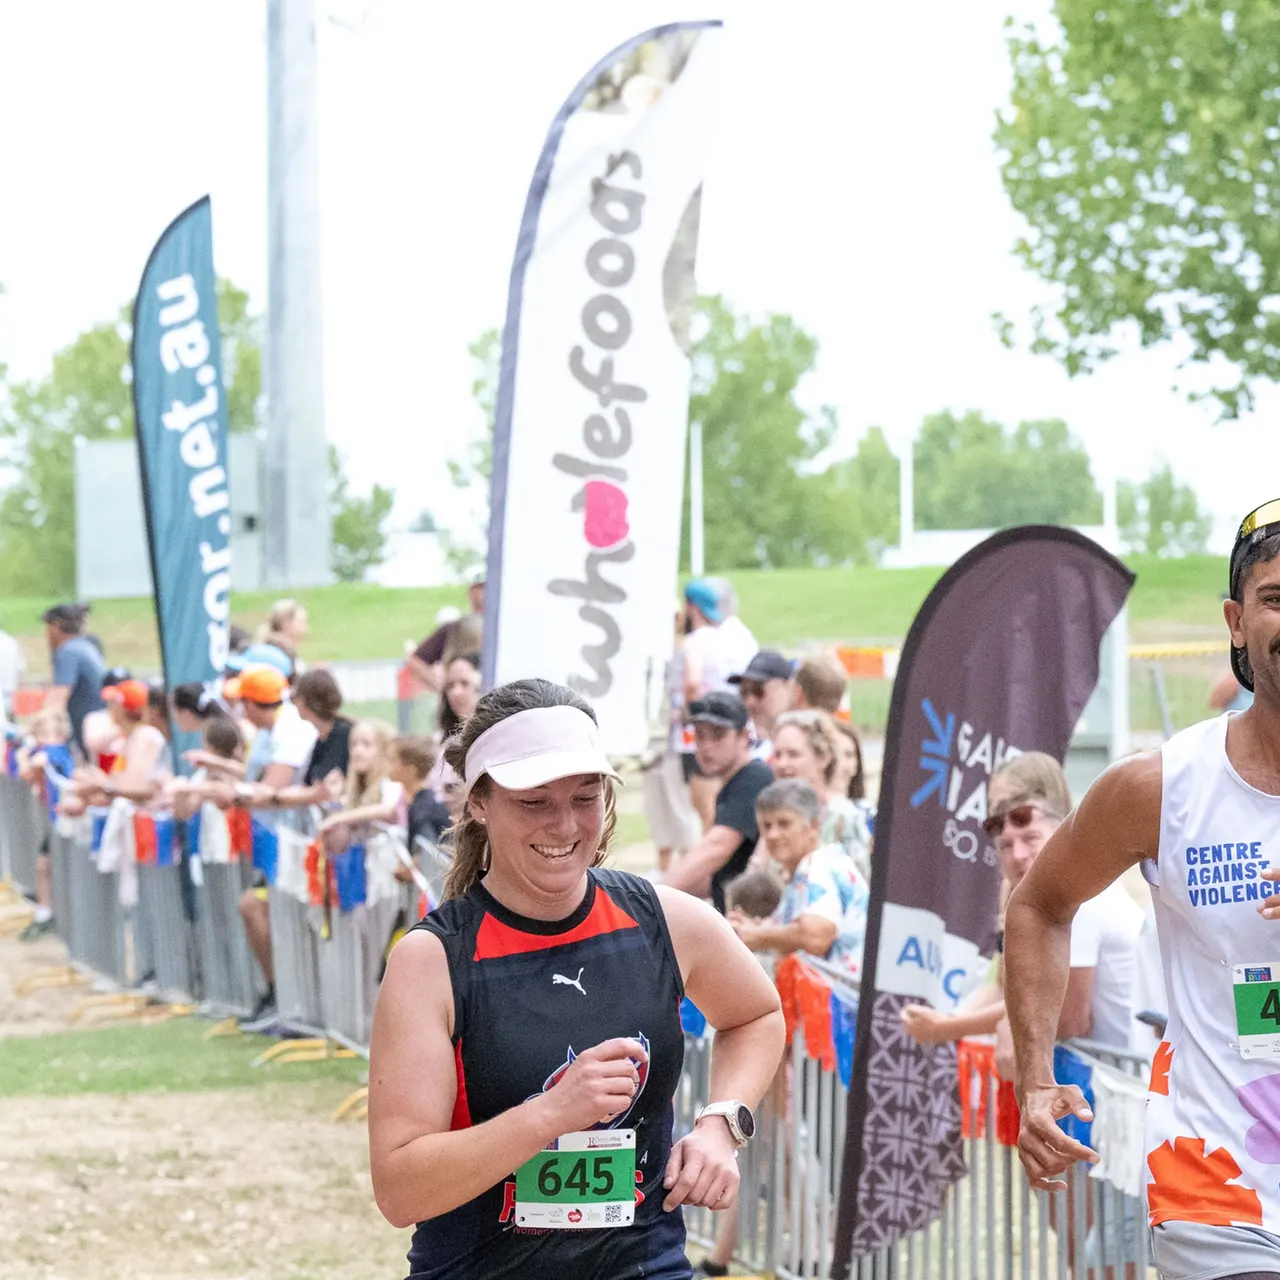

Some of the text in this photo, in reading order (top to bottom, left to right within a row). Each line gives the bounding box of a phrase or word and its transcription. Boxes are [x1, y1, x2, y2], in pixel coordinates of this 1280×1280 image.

[1186, 841, 1263, 866] CENTRE
[1187, 860, 1271, 887] AGAINST
[537, 1156, 614, 1197] 645
